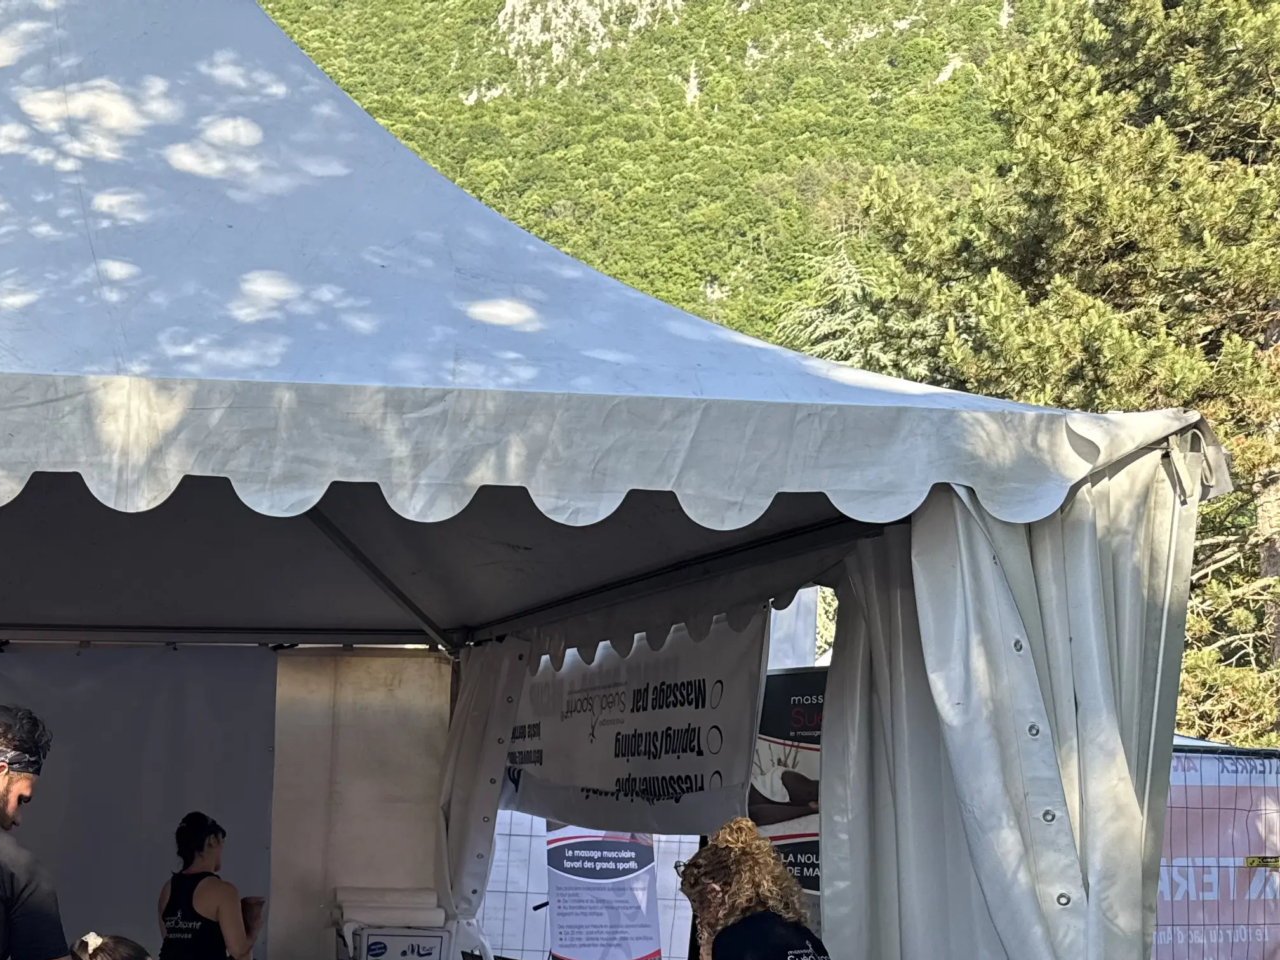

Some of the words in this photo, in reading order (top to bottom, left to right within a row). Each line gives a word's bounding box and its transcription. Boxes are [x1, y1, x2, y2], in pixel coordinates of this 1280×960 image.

[630, 682, 649, 713] par
[651, 678, 706, 710] Massage
[614, 723, 704, 762] Taping/Straping
[565, 848, 572, 857] Le
[574, 849, 601, 859] massage
[603, 850, 636, 859] musculaire
[781, 853, 794, 864] LA
[564, 860, 582, 869] favori
[583, 860, 594, 869] des
[596, 860, 615, 870] grands
[617, 860, 638, 871] sportifs
